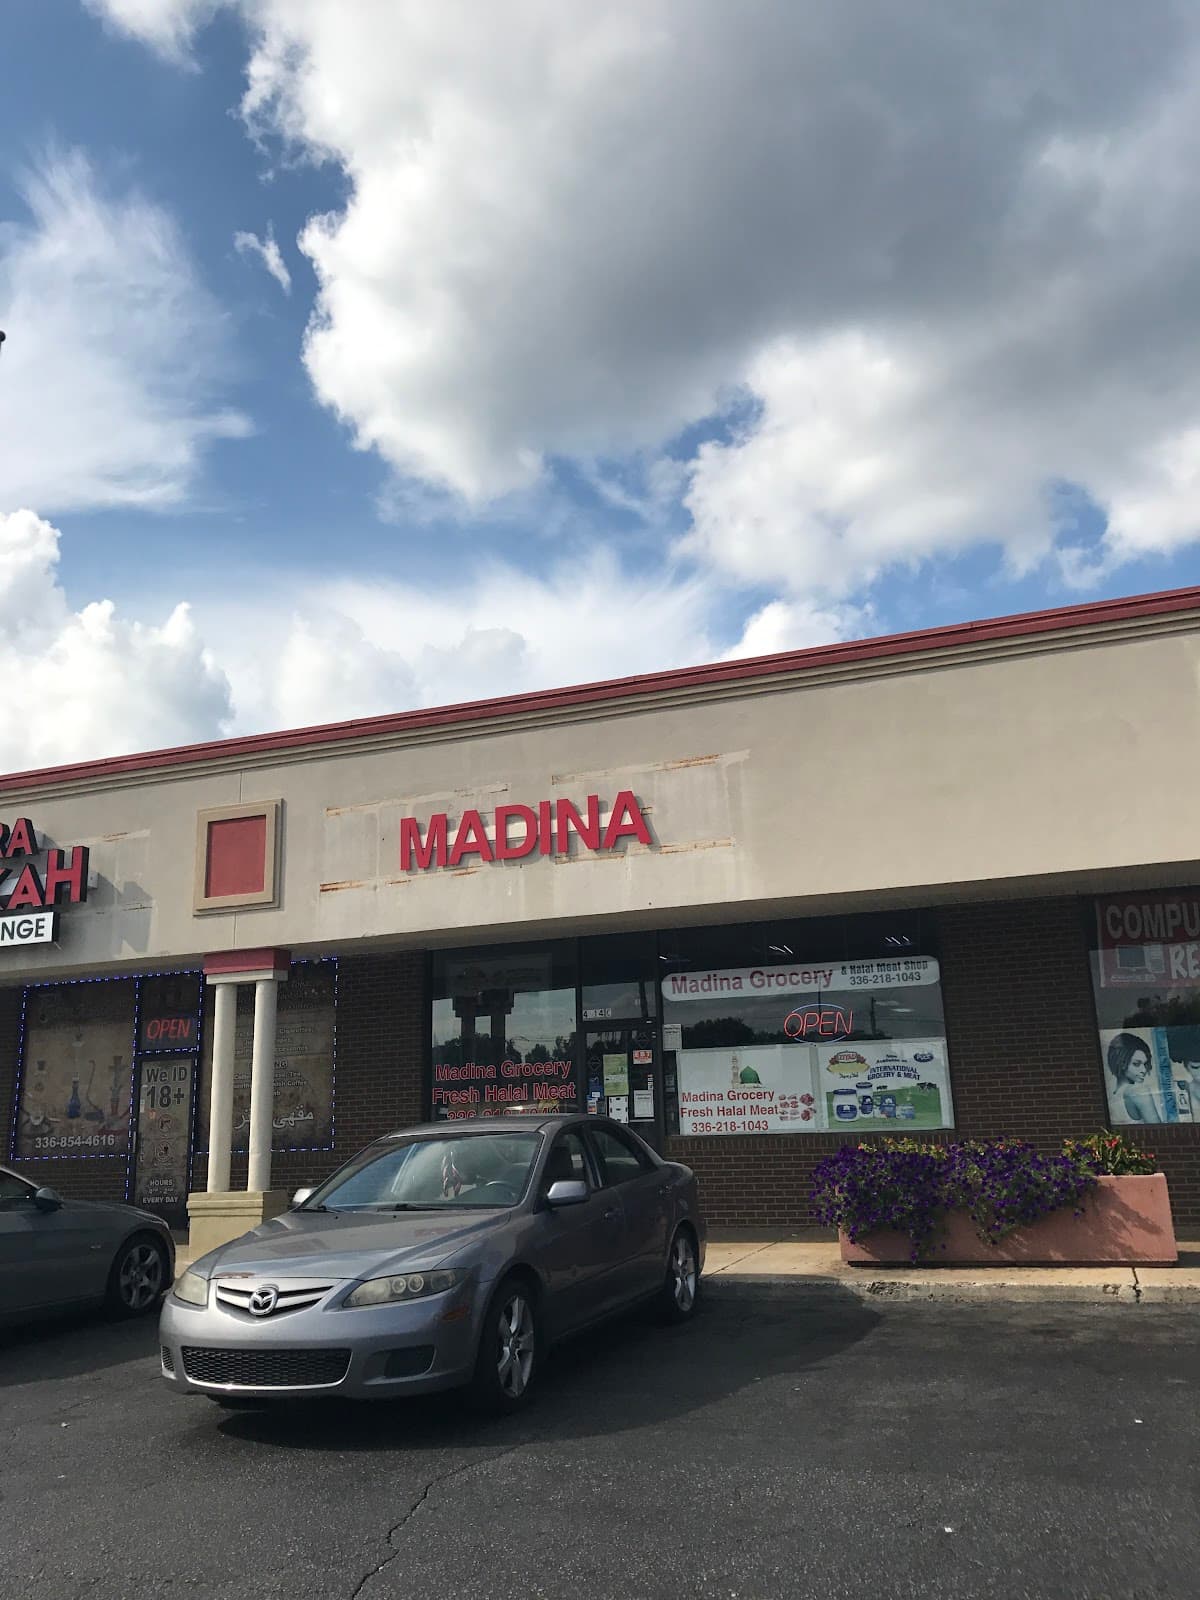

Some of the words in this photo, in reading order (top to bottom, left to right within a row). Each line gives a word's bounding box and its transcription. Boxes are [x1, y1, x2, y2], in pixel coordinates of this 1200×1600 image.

[400, 790, 652, 871] MADINA
[0, 918, 46, 941] NGE
[671, 974, 743, 995] Madina
[749, 967, 833, 990] Grocery
[841, 967, 848, 976] &
[849, 964, 875, 976] Halal
[876, 962, 903, 974] Meat
[903, 959, 929, 972] Shop
[849, 971, 921, 986] 336-218-1043
[146, 1017, 190, 1040] OPEN
[784, 1009, 853, 1037] OPEN
[146, 1067, 168, 1083] We
[172, 1066, 188, 1082] ID
[435, 1062, 497, 1081] Madina
[500, 1059, 572, 1079] Grocery
[867, 1071, 895, 1081] GROCERY
[903, 1072, 921, 1081] MEAT
[870, 1065, 917, 1074] INTERNATIONAL
[146, 1085, 185, 1109] 18+
[432, 1085, 481, 1105] Fresh
[484, 1082, 529, 1103] Halal
[532, 1081, 577, 1101] Meat
[682, 1091, 724, 1103] Madina
[726, 1090, 775, 1103] Grocery
[680, 1106, 713, 1118] Fresh
[717, 1105, 746, 1117] Halal
[749, 1104, 780, 1116] Meat
[691, 1120, 770, 1133] 336-218-1043
[34, 1134, 115, 1149] 336-854-4616
[150, 1178, 173, 1186] HOURS
[142, 1196, 164, 1204] EVERY
[165, 1195, 179, 1203] DAY
